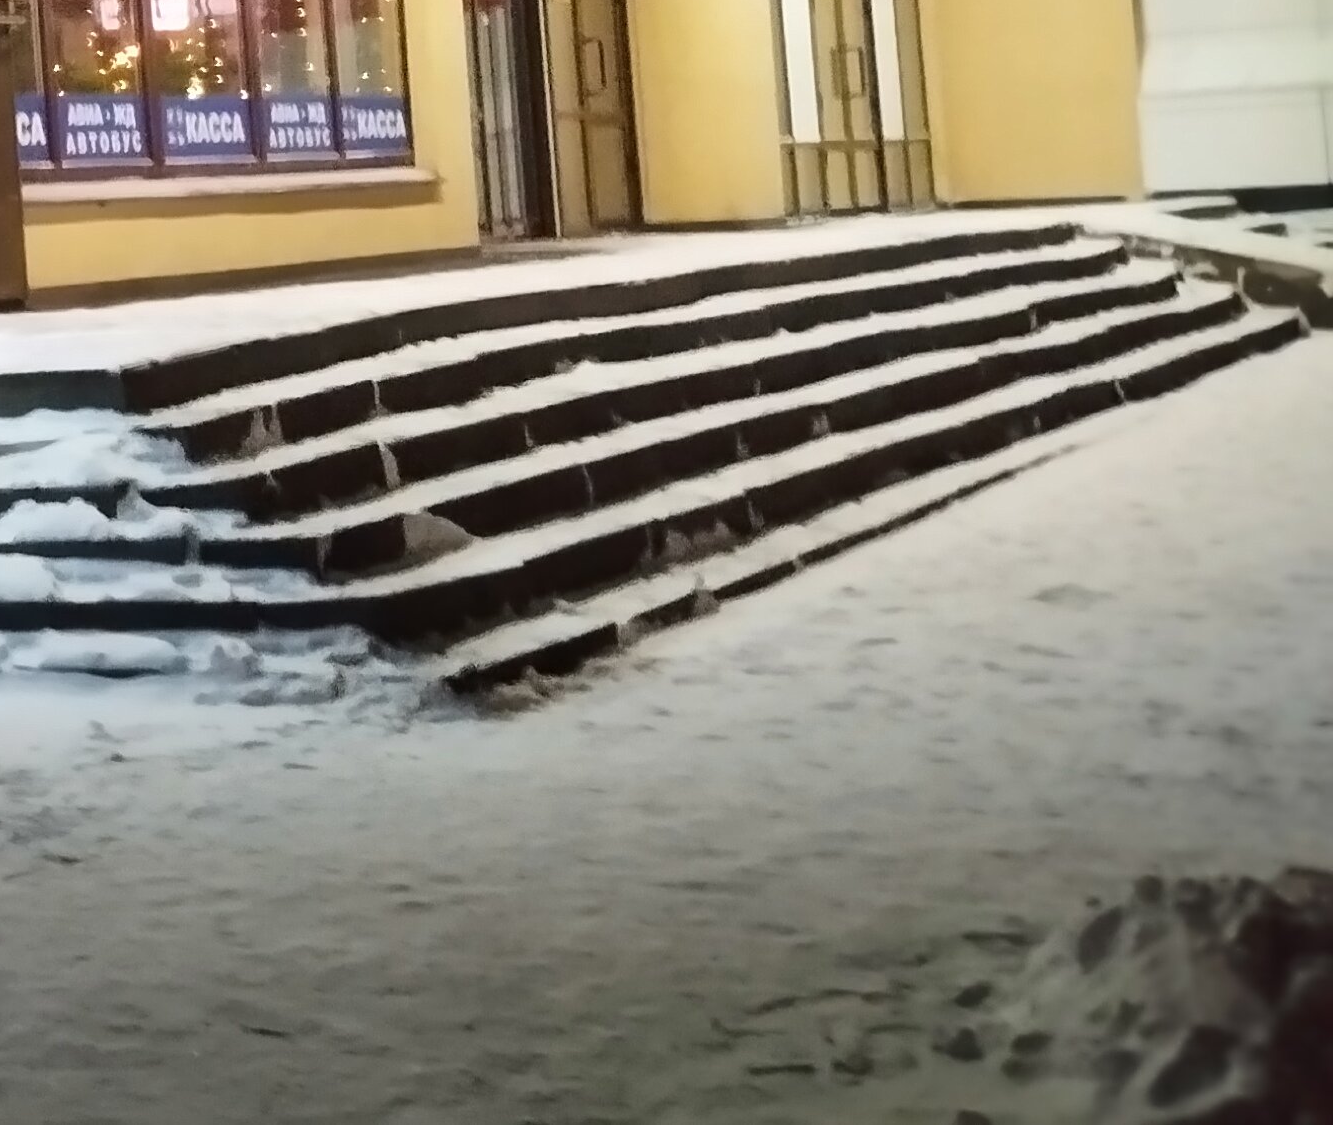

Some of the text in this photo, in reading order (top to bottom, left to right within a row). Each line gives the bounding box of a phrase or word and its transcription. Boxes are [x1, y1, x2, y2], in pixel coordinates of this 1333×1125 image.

[185, 111, 246, 144] КАССА
[269, 126, 331, 149] АВТОБУС
[356, 108, 406, 139] КАССА
[66, 130, 143, 156] АВТОБУС
